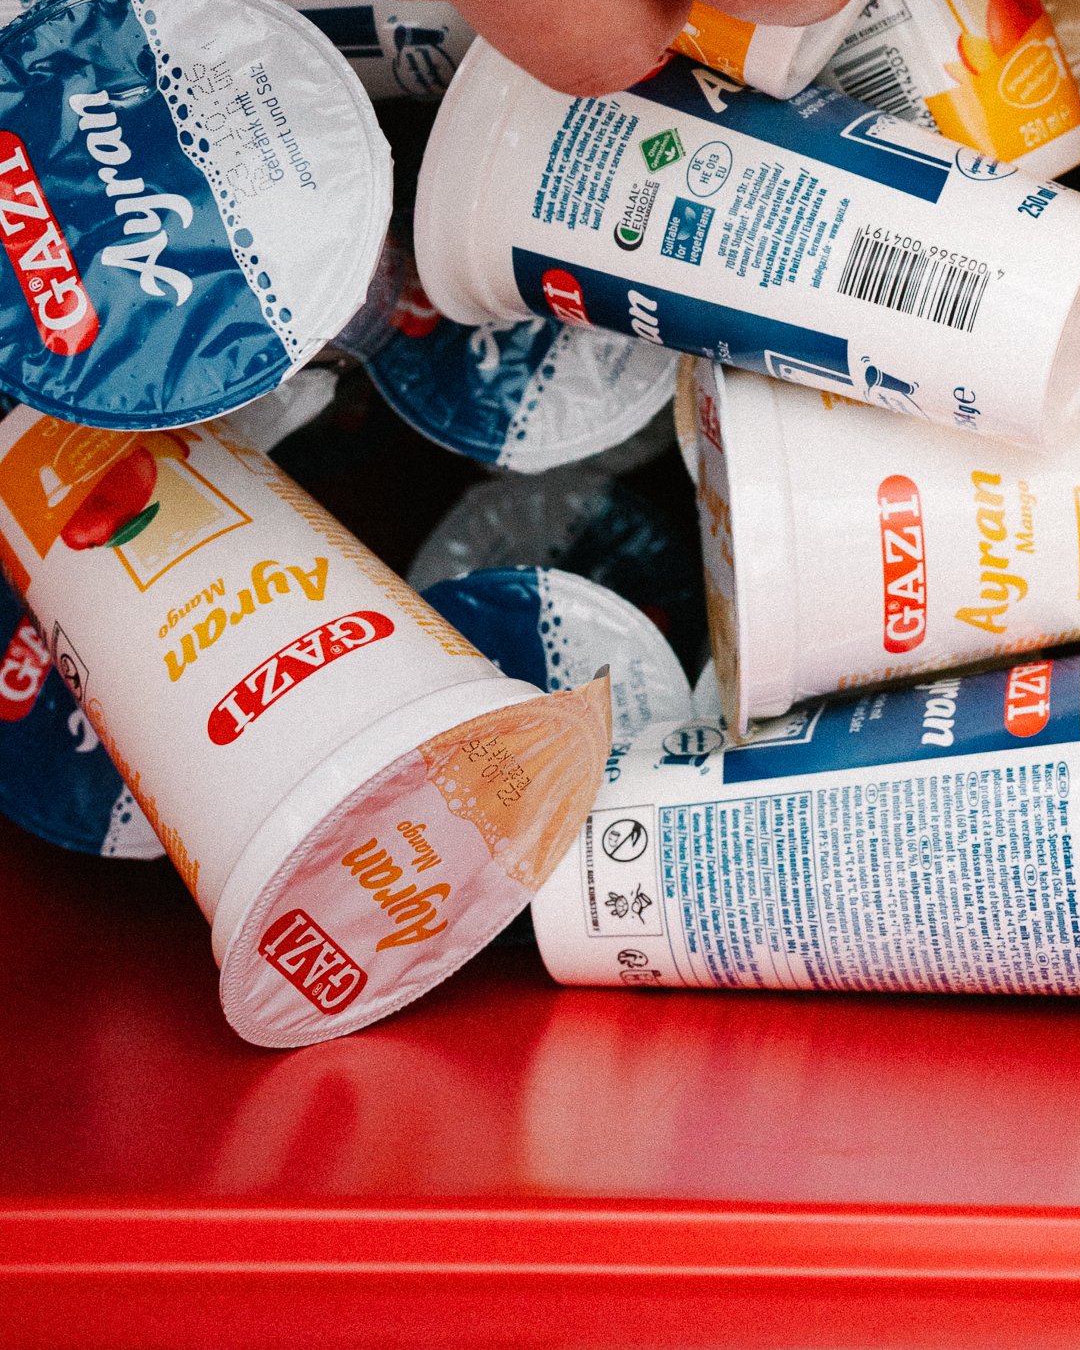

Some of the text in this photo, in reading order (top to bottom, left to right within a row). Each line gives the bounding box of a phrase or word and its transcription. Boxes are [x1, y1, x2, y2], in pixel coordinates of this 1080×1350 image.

[233, 91, 256, 116] mit
[248, 61, 272, 95] Salz
[261, 96, 287, 127] und
[246, 117, 285, 183] Getränk
[275, 128, 316, 193] Joghurt
[578, 112, 627, 225] Schud goed en drink het lekker
[590, 115, 640, 230] koud! Agitare servire freddo!
[692, 158, 704, 171] DE
[699, 153, 720, 184] HE 013
[715, 165, 728, 178] EU
[72, 89, 194, 307] Ayran
[620, 187, 640, 227] HALAL
[630, 178, 655, 230] EUROPE
[716, 167, 755, 257] garmo AG Ulmer Str. 173
[725, 166, 768, 269] 70188 Stuttgart Deutschland
[735, 166, 783, 277] Germany Allemagne Duitsland
[751, 178, 790, 269] Germania Hergestellt in
[1016, 183, 1057, 222] 250 ml
[661, 216, 682, 255] Suitable
[675, 243, 688, 259] for
[686, 206, 713, 263] vegetarians
[758, 172, 808, 288] Deutschland Made in Germany
[806, 220, 827, 256] Germania
[810, 196, 851, 288] info@gazi.de www.gazi.de
[863, 223, 1007, 281] 4 002566 004191
[545, 282, 583, 325] ZI
[1016, 480, 1039, 553] Mango
[883, 494, 925, 641] GAZI
[954, 469, 1029, 635] Ayran
[157, 577, 226, 636] Mango
[165, 557, 329, 683] Ayran
[3, 636, 53, 702] GA
[219, 614, 376, 732] GAZI
[1009, 660, 1049, 718] AZI
[921, 679, 961, 748] ran
[461, 736, 521, 808] 22.10.26
[1044, 795, 1057, 831] jodiertes
[1058, 799, 1070, 826] Ayran
[396, 821, 443, 871] Mango
[1005, 767, 1030, 940] and salt Ingredients: yogurt milk
[1021, 819, 1039, 911] verzehren. Ayran
[1034, 813, 1056, 933] siehe Deckel. Nach dem Öffnen
[1047, 833, 1062, 876] Speisesalz
[1061, 834, 1074, 868] Getränk
[342, 838, 451, 953] Ayran
[1065, 871, 1075, 885] mit
[1065, 888, 1079, 919] Joghurt
[1070, 920, 1080, 933] und
